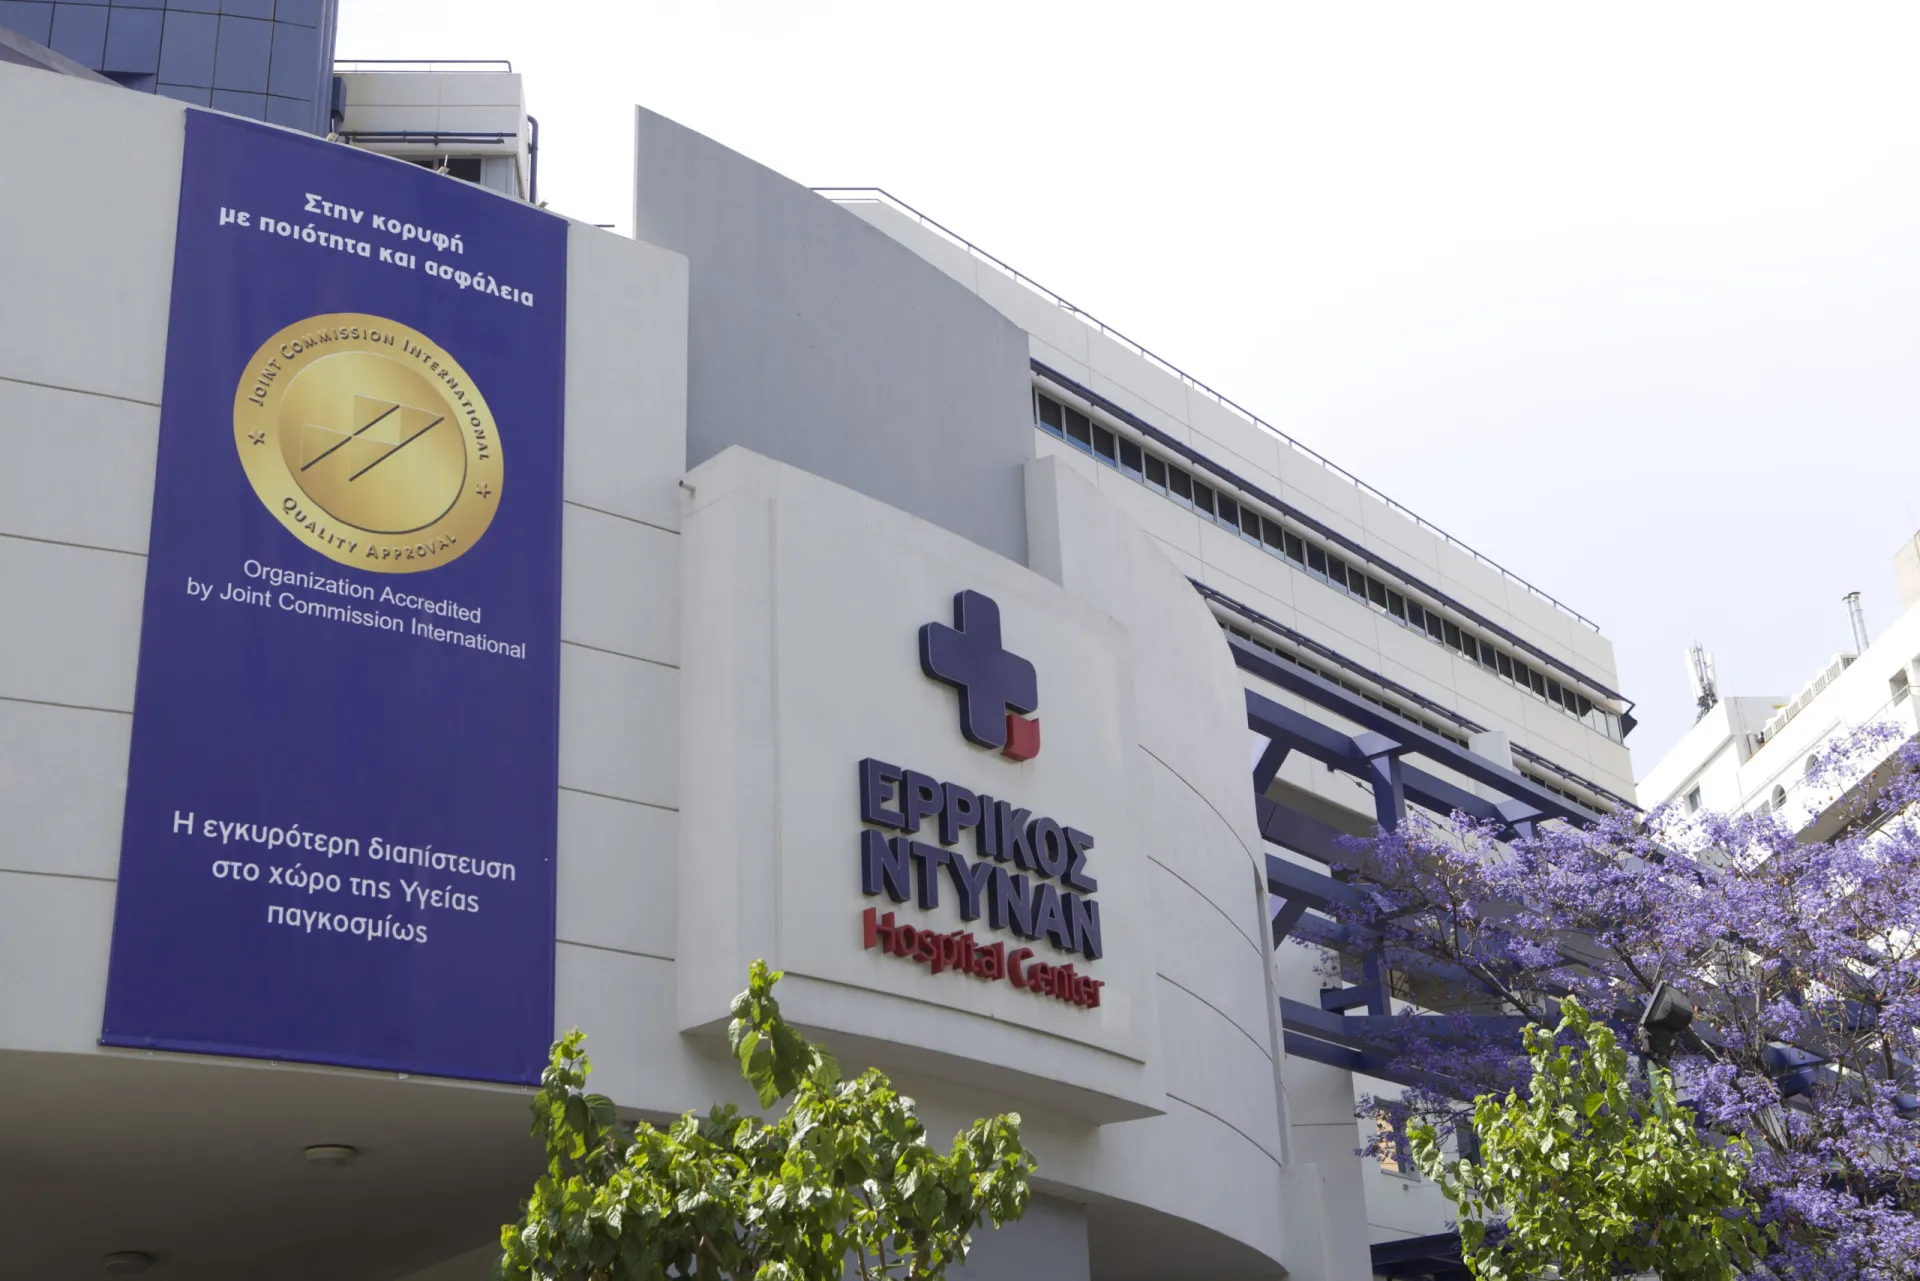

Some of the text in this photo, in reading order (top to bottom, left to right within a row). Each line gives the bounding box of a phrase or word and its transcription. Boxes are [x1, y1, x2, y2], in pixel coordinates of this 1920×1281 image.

[219, 206, 535, 307] με ποιότητα και ασφάλεια
[304, 192, 465, 255] Στην κορυφή
[248, 326, 490, 461] JOINT COMMISSION INTERNATIONAL
[282, 496, 457, 561] QUALITY APPROVAL
[187, 577, 526, 660] by Joint Commission International
[243, 559, 482, 624] Organization Accredited
[173, 810, 516, 881] Η εγκυρότερη διαπίστευση
[859, 757, 1098, 894] ΕΡΡΙΚΟΣ
[212, 859, 480, 913] στο χώρο της Υγείας
[267, 905, 428, 944] παγκοσμίως
[861, 829, 1103, 961] ΝΤΥΝΑΝ
[863, 907, 1105, 1009] Hospital Center
